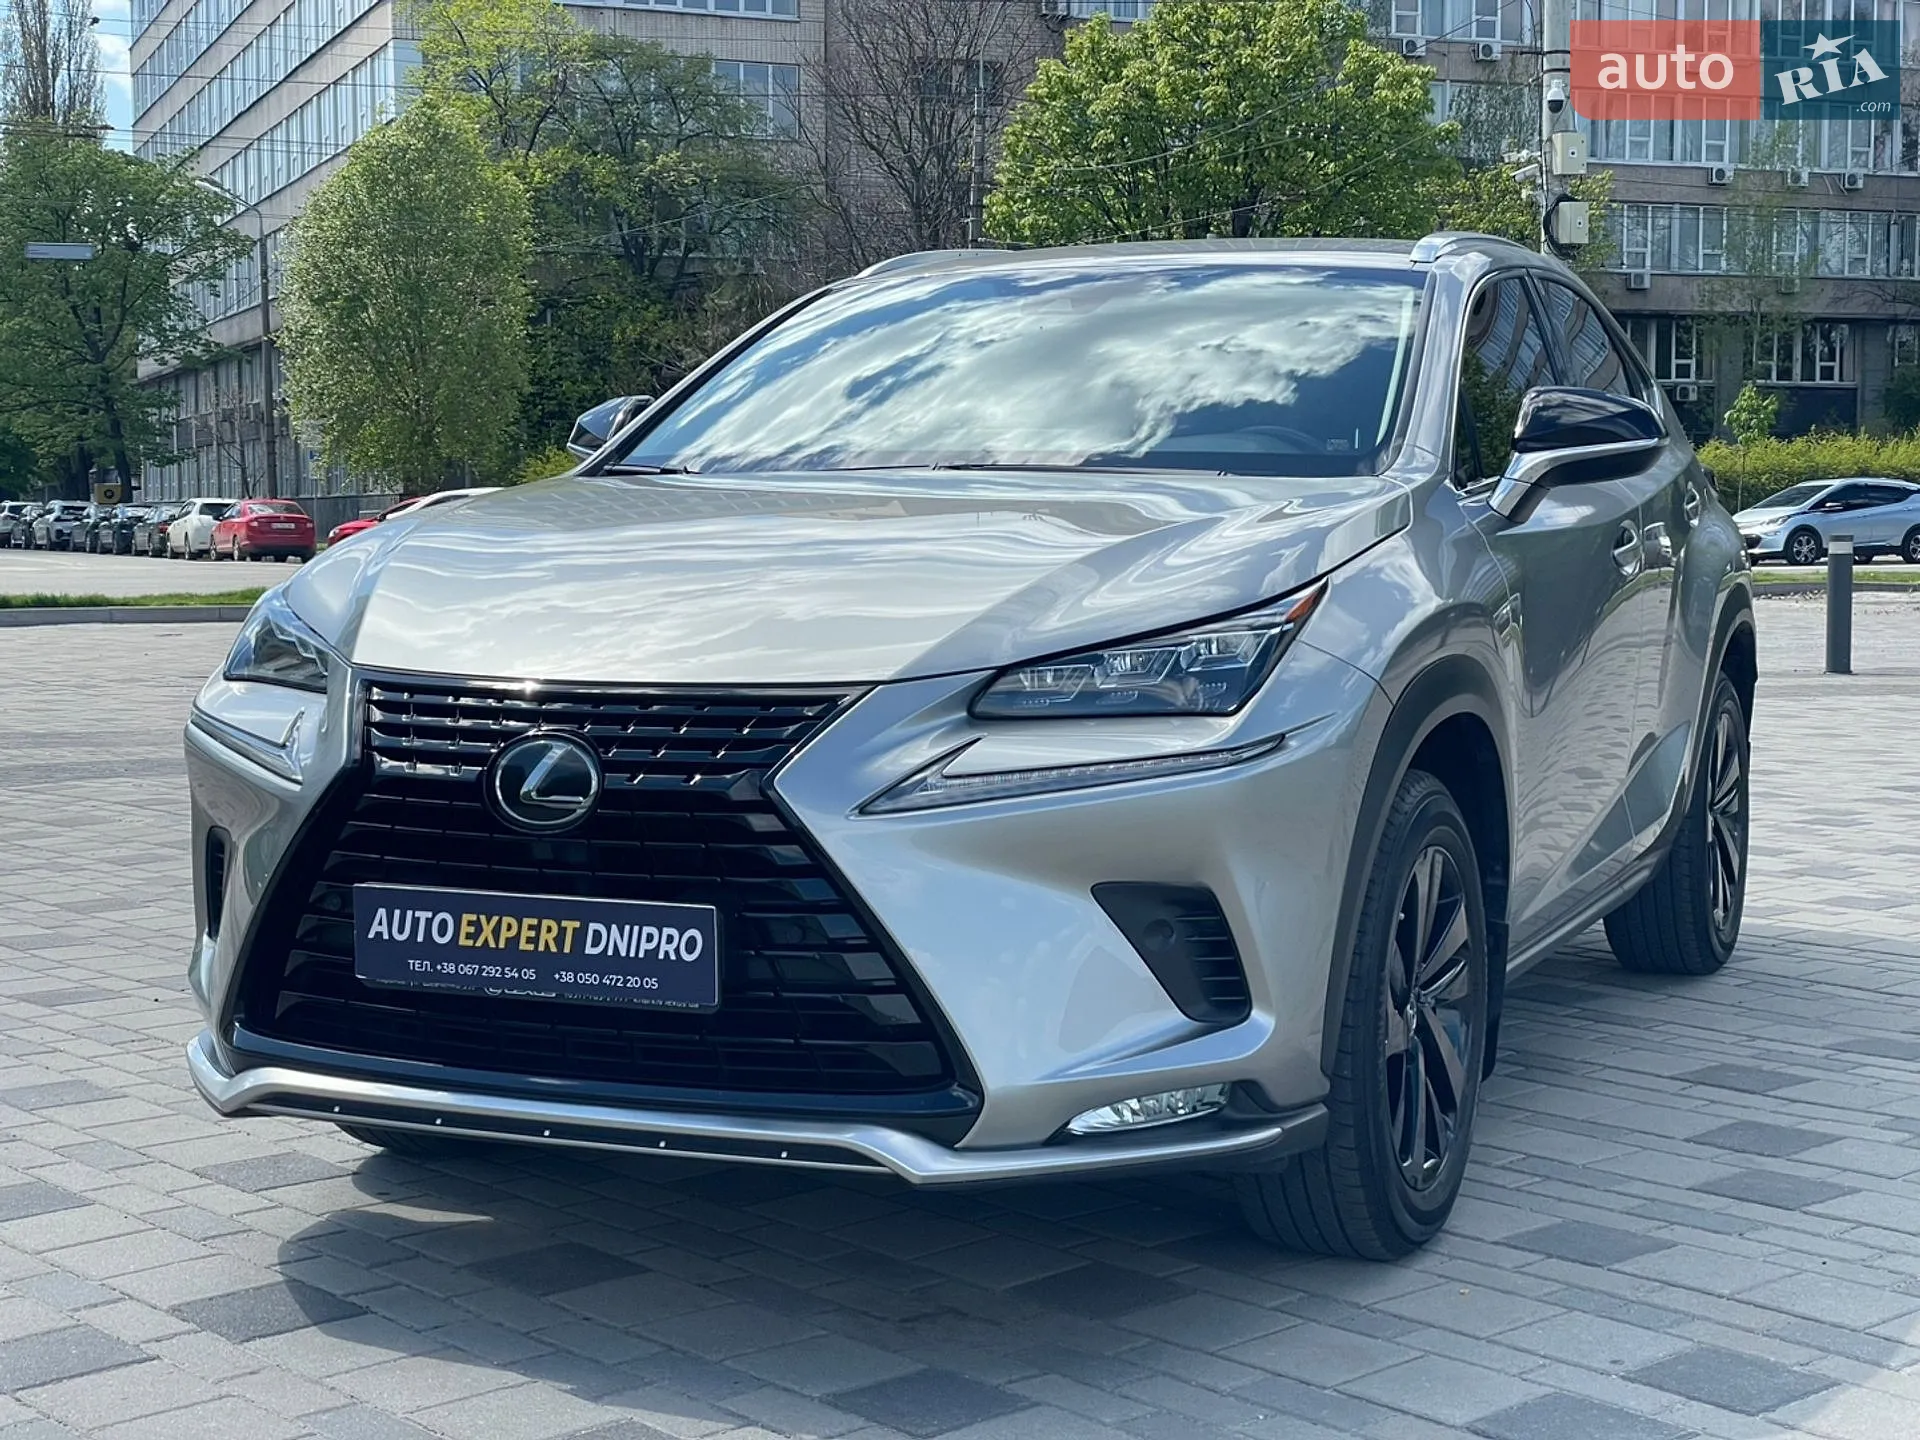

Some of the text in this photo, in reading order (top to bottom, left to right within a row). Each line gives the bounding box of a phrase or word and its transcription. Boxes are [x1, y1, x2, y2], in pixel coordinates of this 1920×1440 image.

[367, 907, 703, 962] AUTO EXPERT DNIPRO
[407, 959, 659, 989] ТЕЛ. +38 067 292 54 05 +38 050 472 20 05
